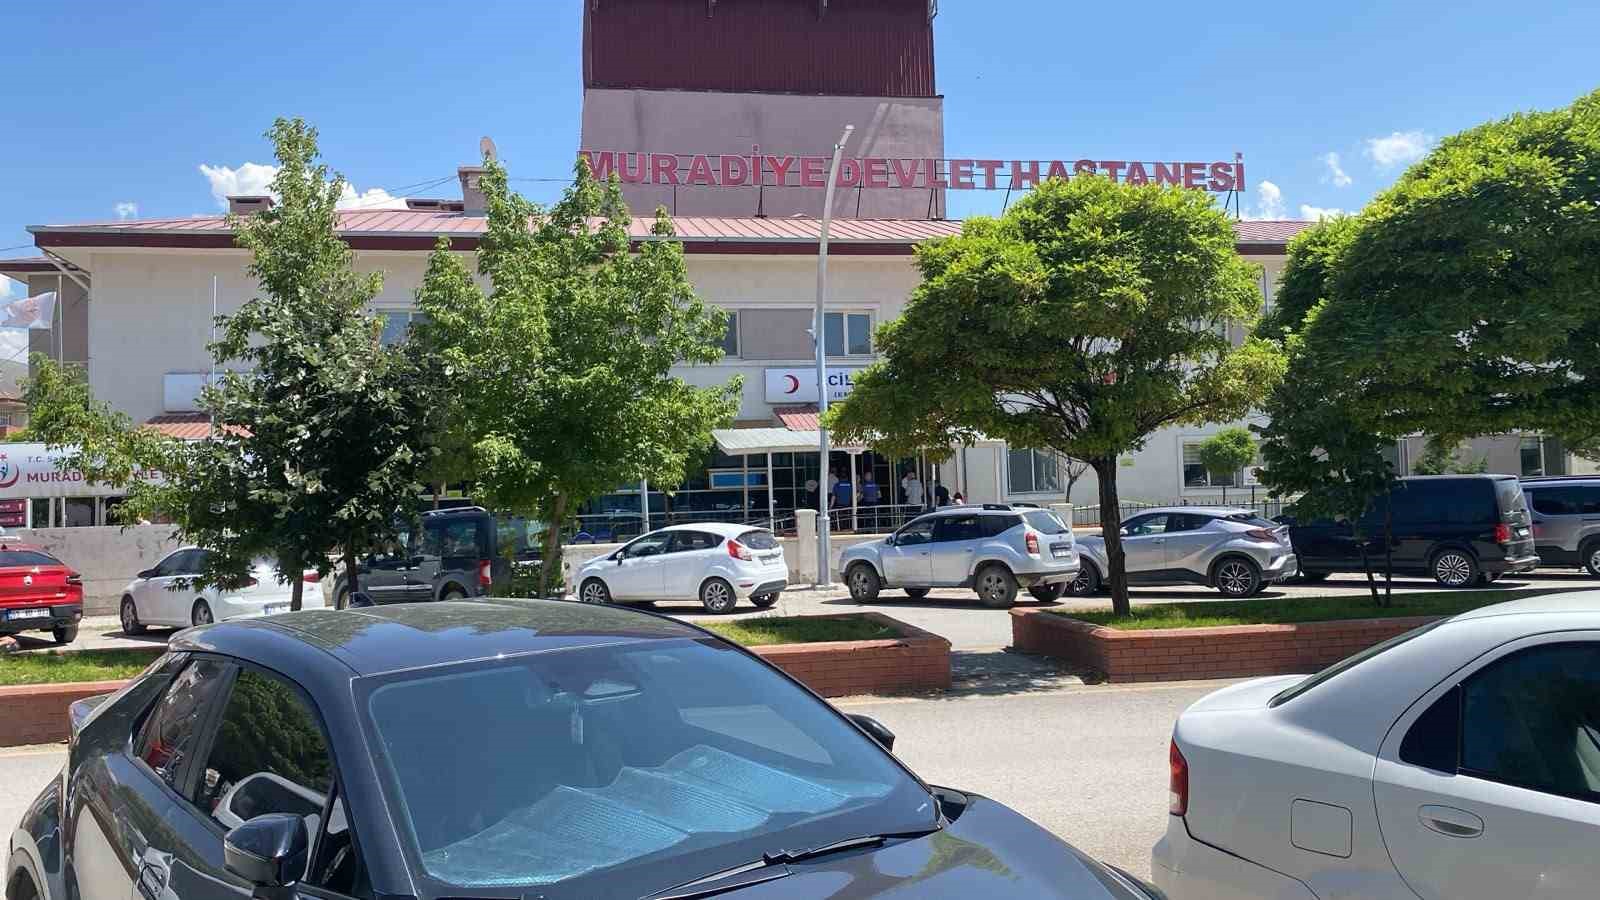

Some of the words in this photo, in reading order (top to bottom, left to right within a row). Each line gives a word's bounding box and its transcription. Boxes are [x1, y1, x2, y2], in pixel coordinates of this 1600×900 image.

[577, 144, 827, 188] MURADİYE
[835, 158, 1004, 189] DEVLET
[828, 372, 855, 386] CİL
